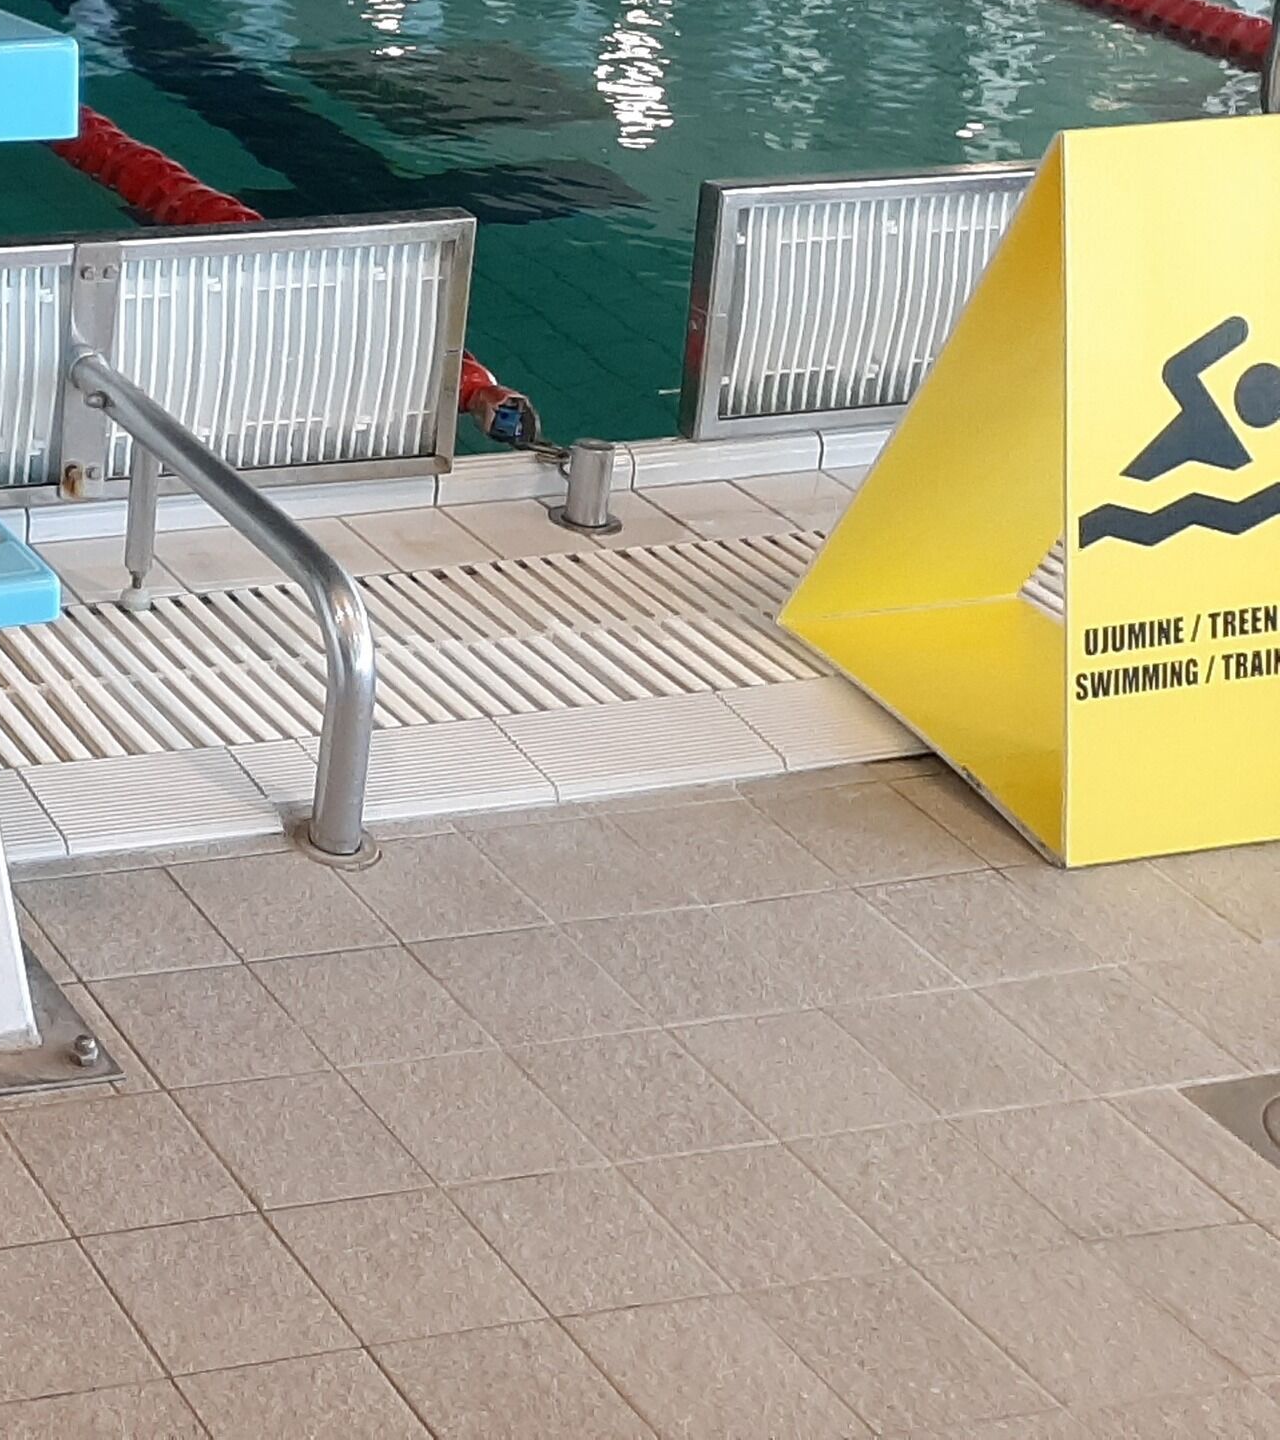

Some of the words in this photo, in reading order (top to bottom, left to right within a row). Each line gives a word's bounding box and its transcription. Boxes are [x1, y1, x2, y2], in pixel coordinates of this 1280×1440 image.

[1085, 616, 1184, 656] UJUMINE
[1190, 614, 1201, 643] /
[1208, 605, 1278, 639] TREEN
[1075, 658, 1199, 701] SWIMMING
[1205, 655, 1216, 684] /
